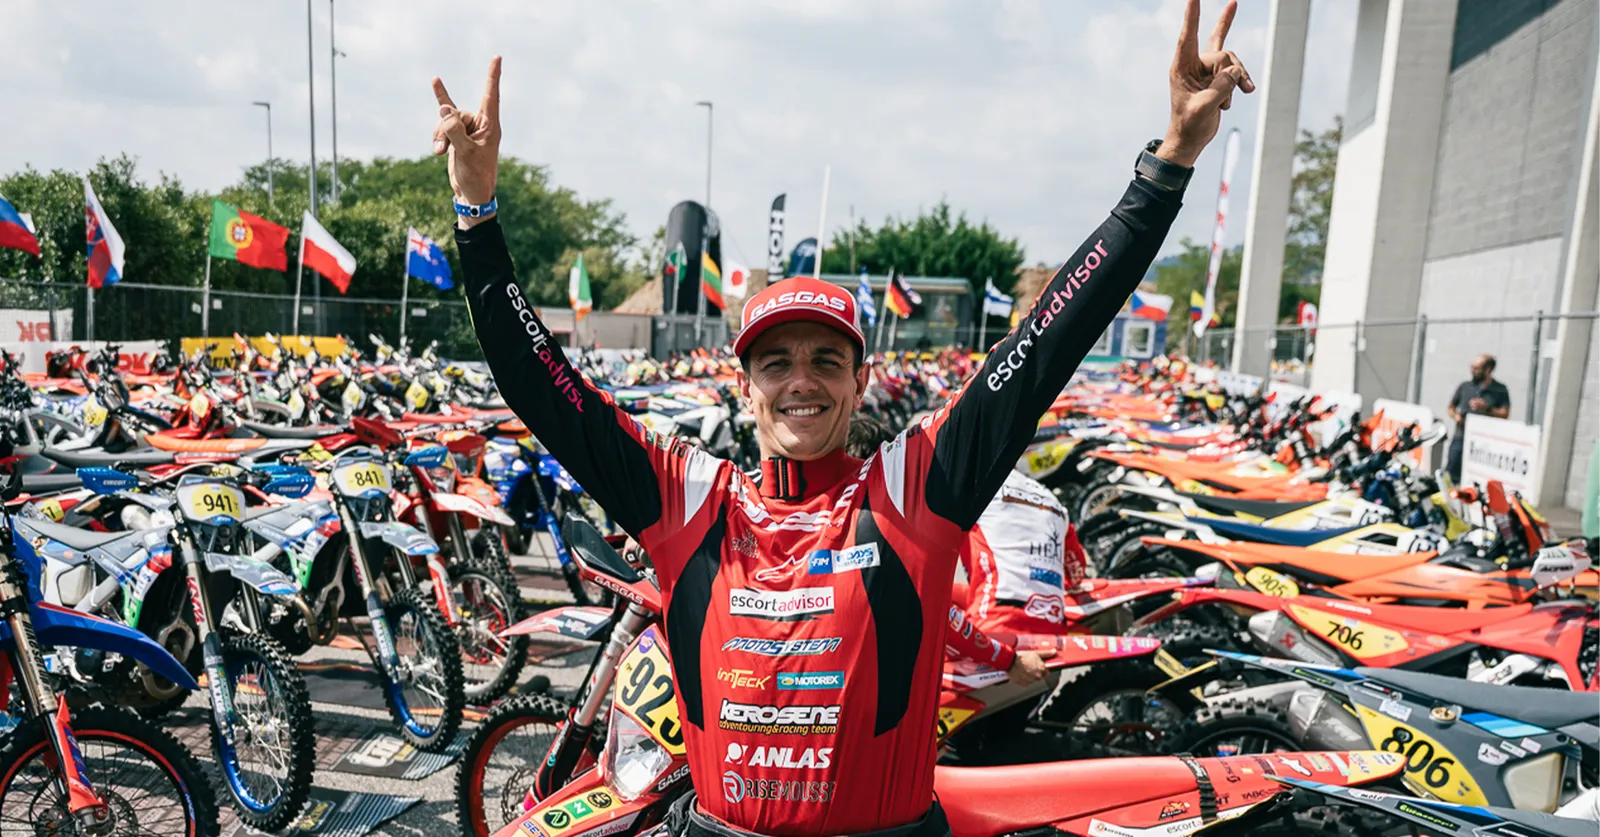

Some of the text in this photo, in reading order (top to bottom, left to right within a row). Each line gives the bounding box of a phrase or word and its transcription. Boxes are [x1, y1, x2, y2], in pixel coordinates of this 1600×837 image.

[750, 291, 846, 319] GASGAS
[355, 470, 380, 486] 841
[203, 493, 233, 513] 941
[593, 575, 645, 605] GASGAS
[1260, 574, 1289, 597] 905
[731, 593, 832, 612] escortadvisor
[1326, 620, 1365, 651] 706
[795, 675, 840, 686] MOTOREX
[811, 724, 837, 734] team
[748, 747, 834, 769] ANLAS
[1381, 726, 1455, 788] 806
